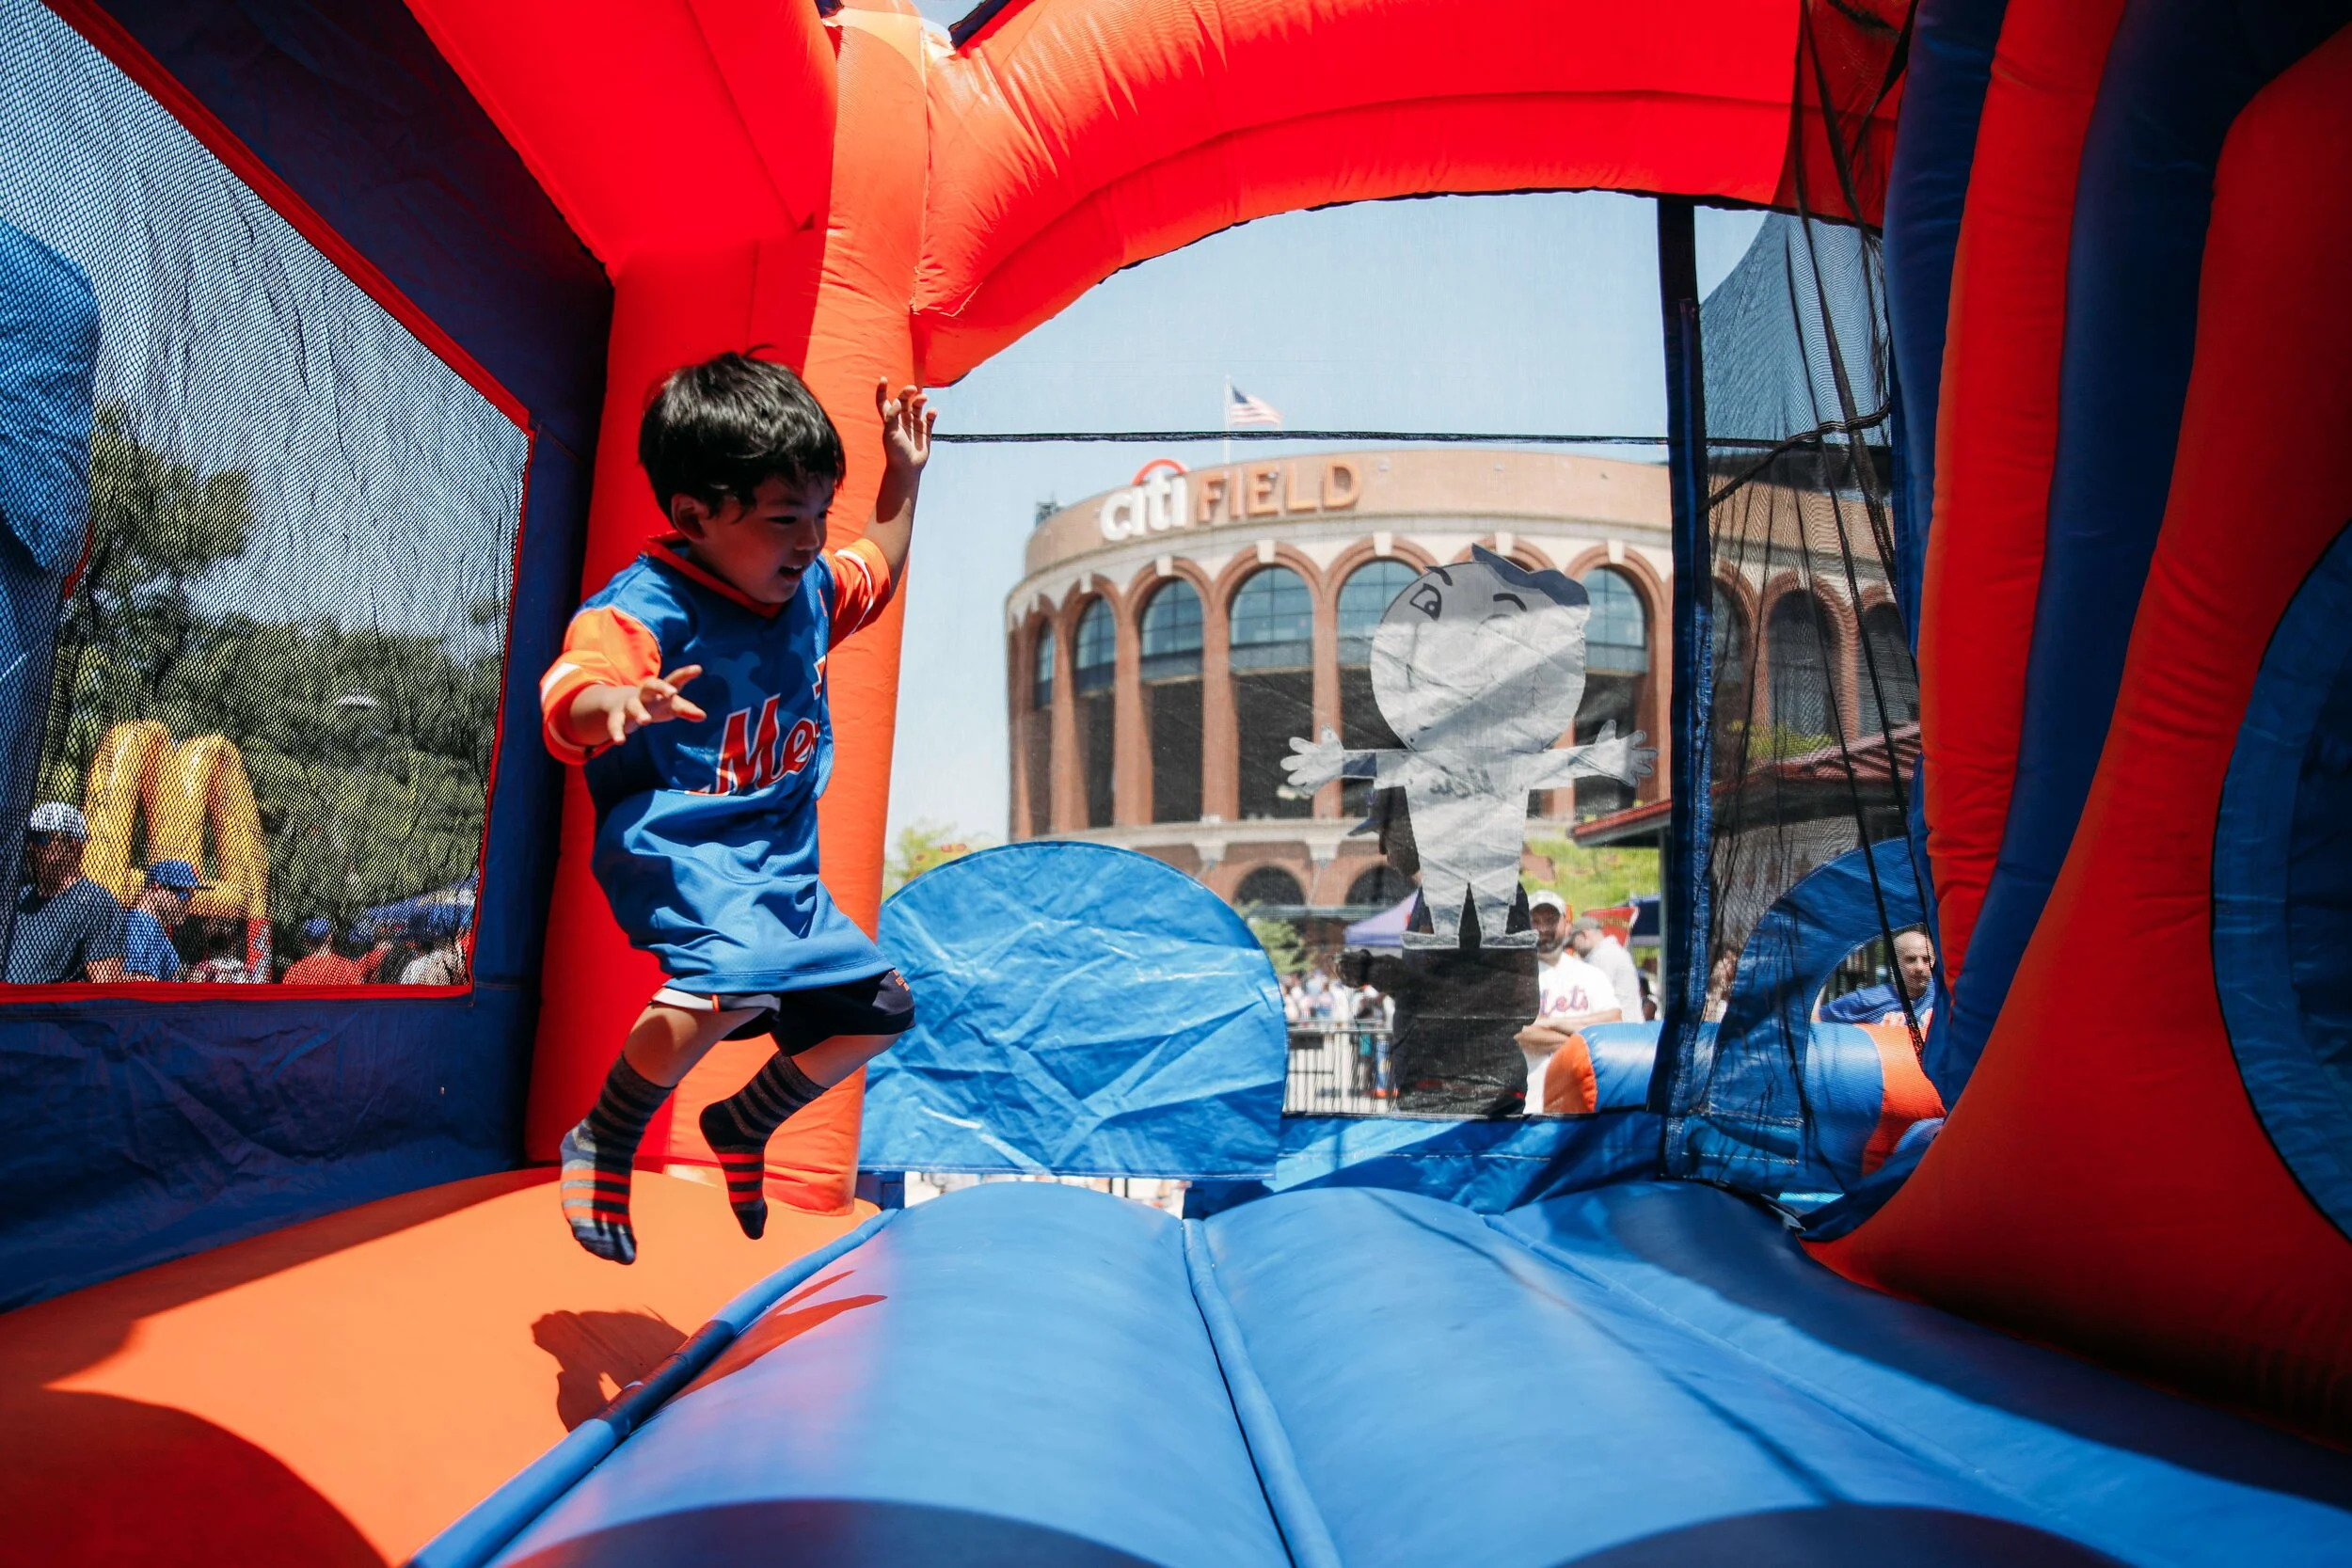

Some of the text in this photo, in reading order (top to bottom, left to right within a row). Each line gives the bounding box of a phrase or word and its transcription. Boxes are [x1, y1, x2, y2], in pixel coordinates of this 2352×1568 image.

[1100, 460, 1361, 542] citi FIELD
[685, 656, 826, 796] Me
